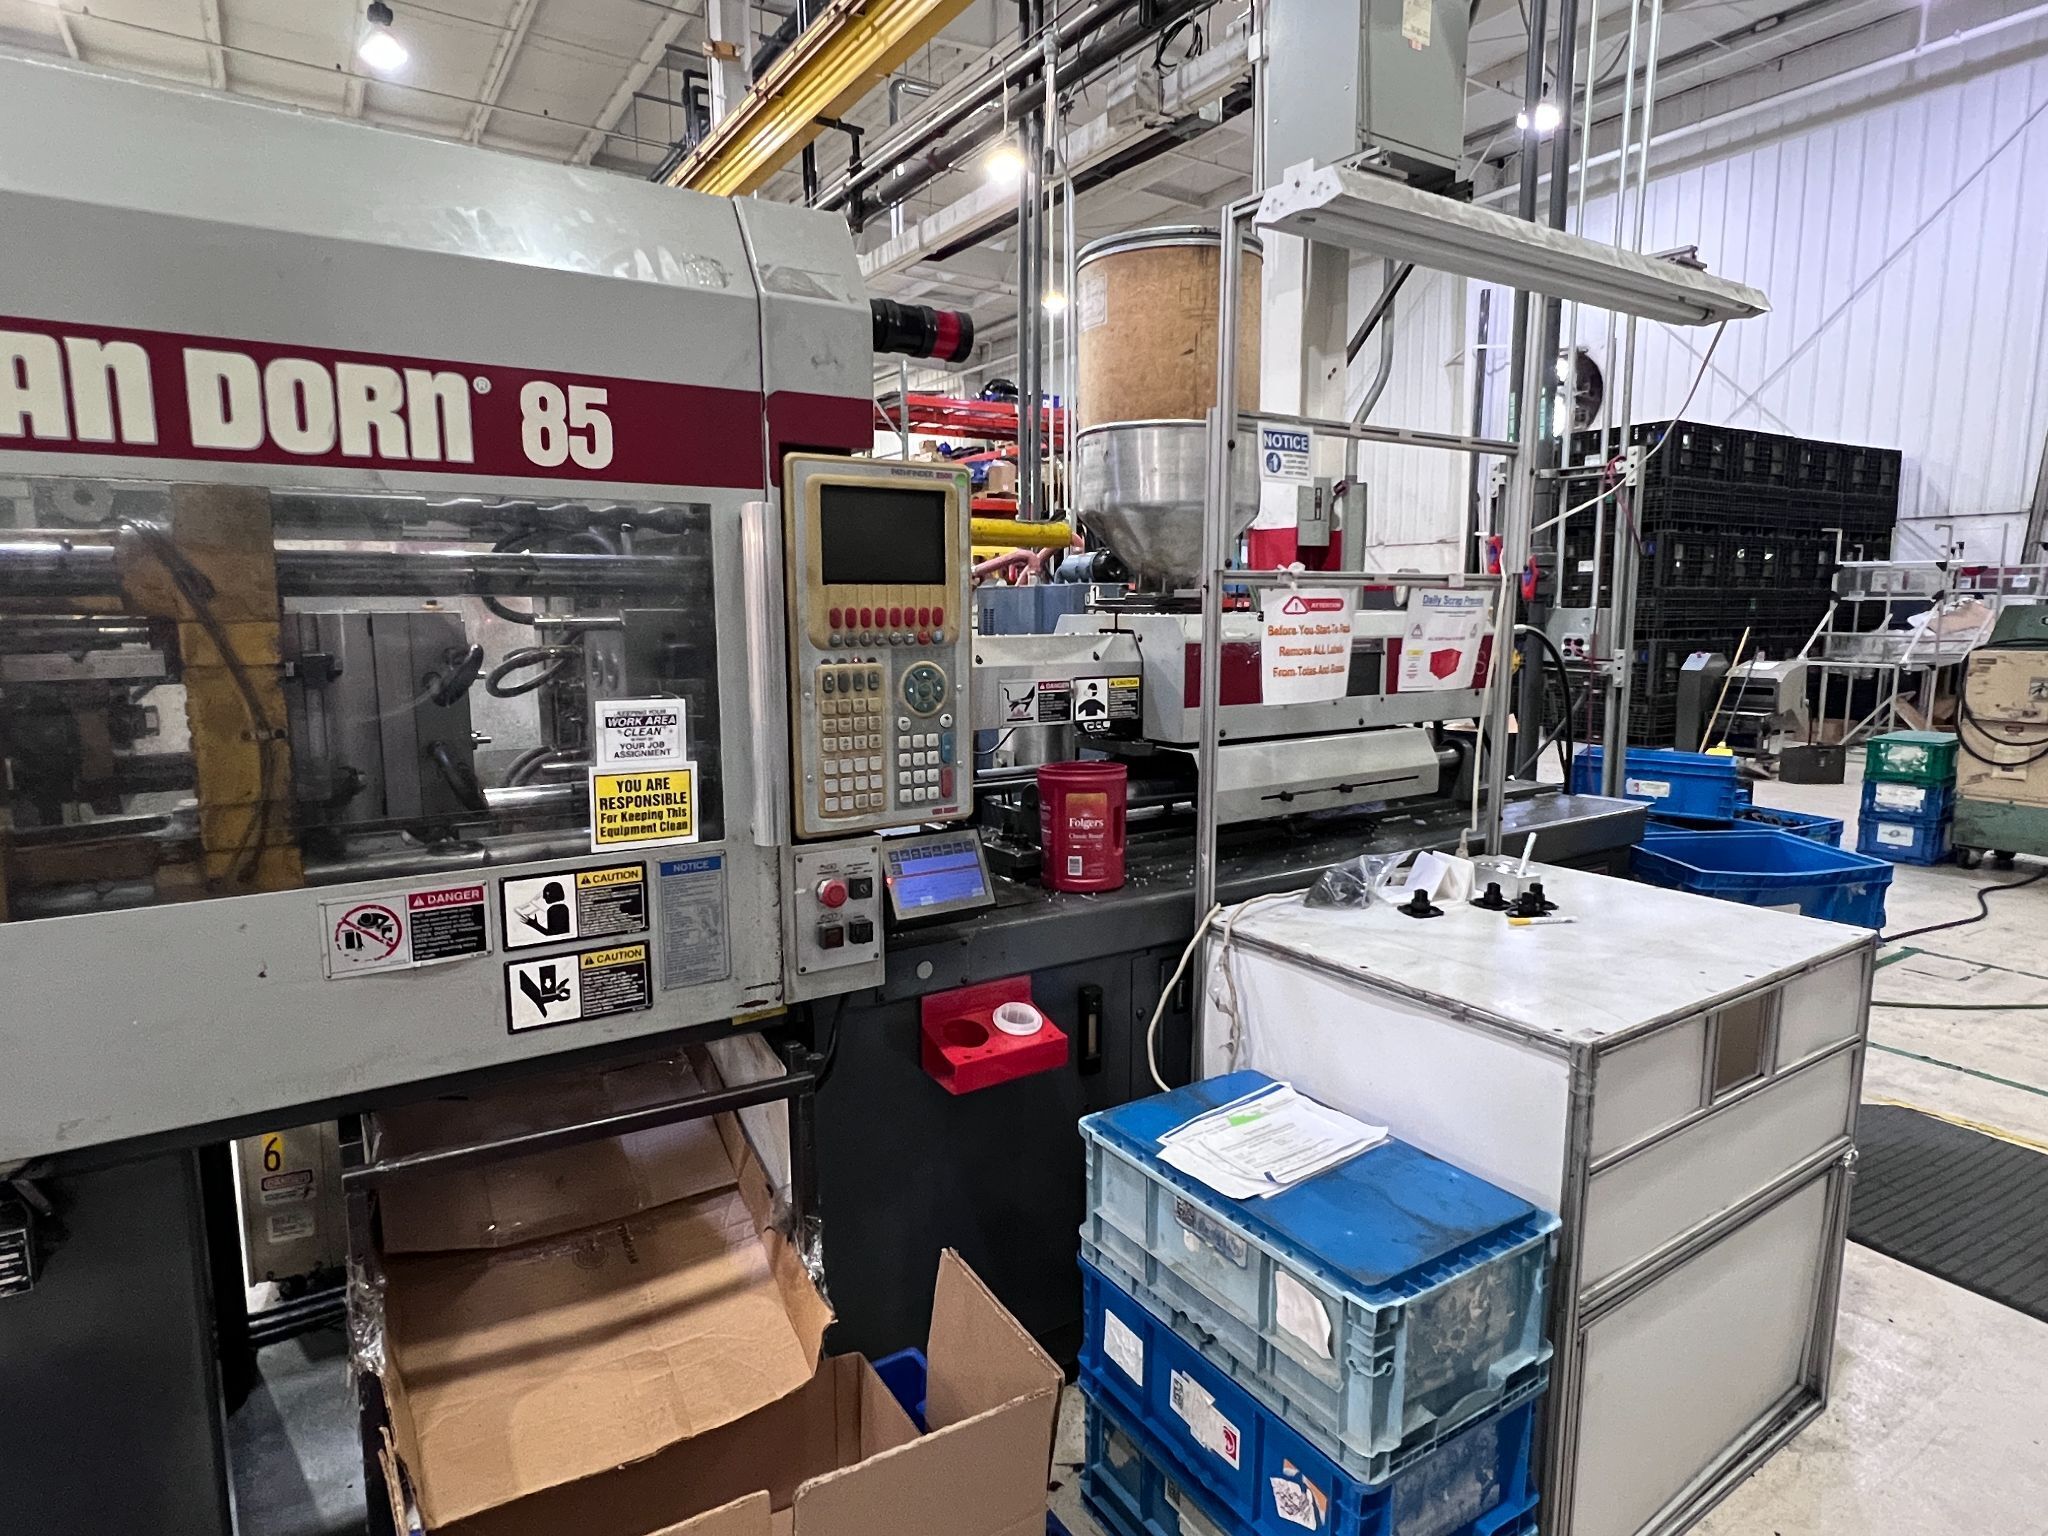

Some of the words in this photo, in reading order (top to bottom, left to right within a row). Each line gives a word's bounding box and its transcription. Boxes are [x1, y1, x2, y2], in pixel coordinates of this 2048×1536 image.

[520, 380, 614, 469] 85
[1264, 433, 1308, 450] NOTICE
[1268, 625, 1297, 636] Before
[1298, 625, 1314, 635] You
[1279, 646, 1312, 656] Remove
[1273, 667, 1296, 677] From
[608, 717, 642, 727] WORK
[645, 716, 676, 726] AREA
[623, 727, 662, 737] CLEAN
[620, 742, 646, 750] YOUR
[648, 741, 665, 749] JOB
[614, 748, 671, 758] ASSIGNMENT
[616, 779, 642, 793] YOU
[646, 777, 670, 791] ARE
[599, 791, 687, 811] RESPONSIBLE
[600, 813, 617, 824] For
[621, 810, 663, 822] Keeping
[666, 807, 687, 818] This
[600, 823, 656, 837] Equipment
[659, 821, 688, 832] Clean
[1069, 817, 1104, 830] Folgers
[673, 861, 710, 873] NOTICE
[592, 869, 639, 883] CAUTION
[427, 889, 480, 904] DANGER
[596, 948, 643, 964] CAUTION
[264, 1137, 281, 1171] 6
